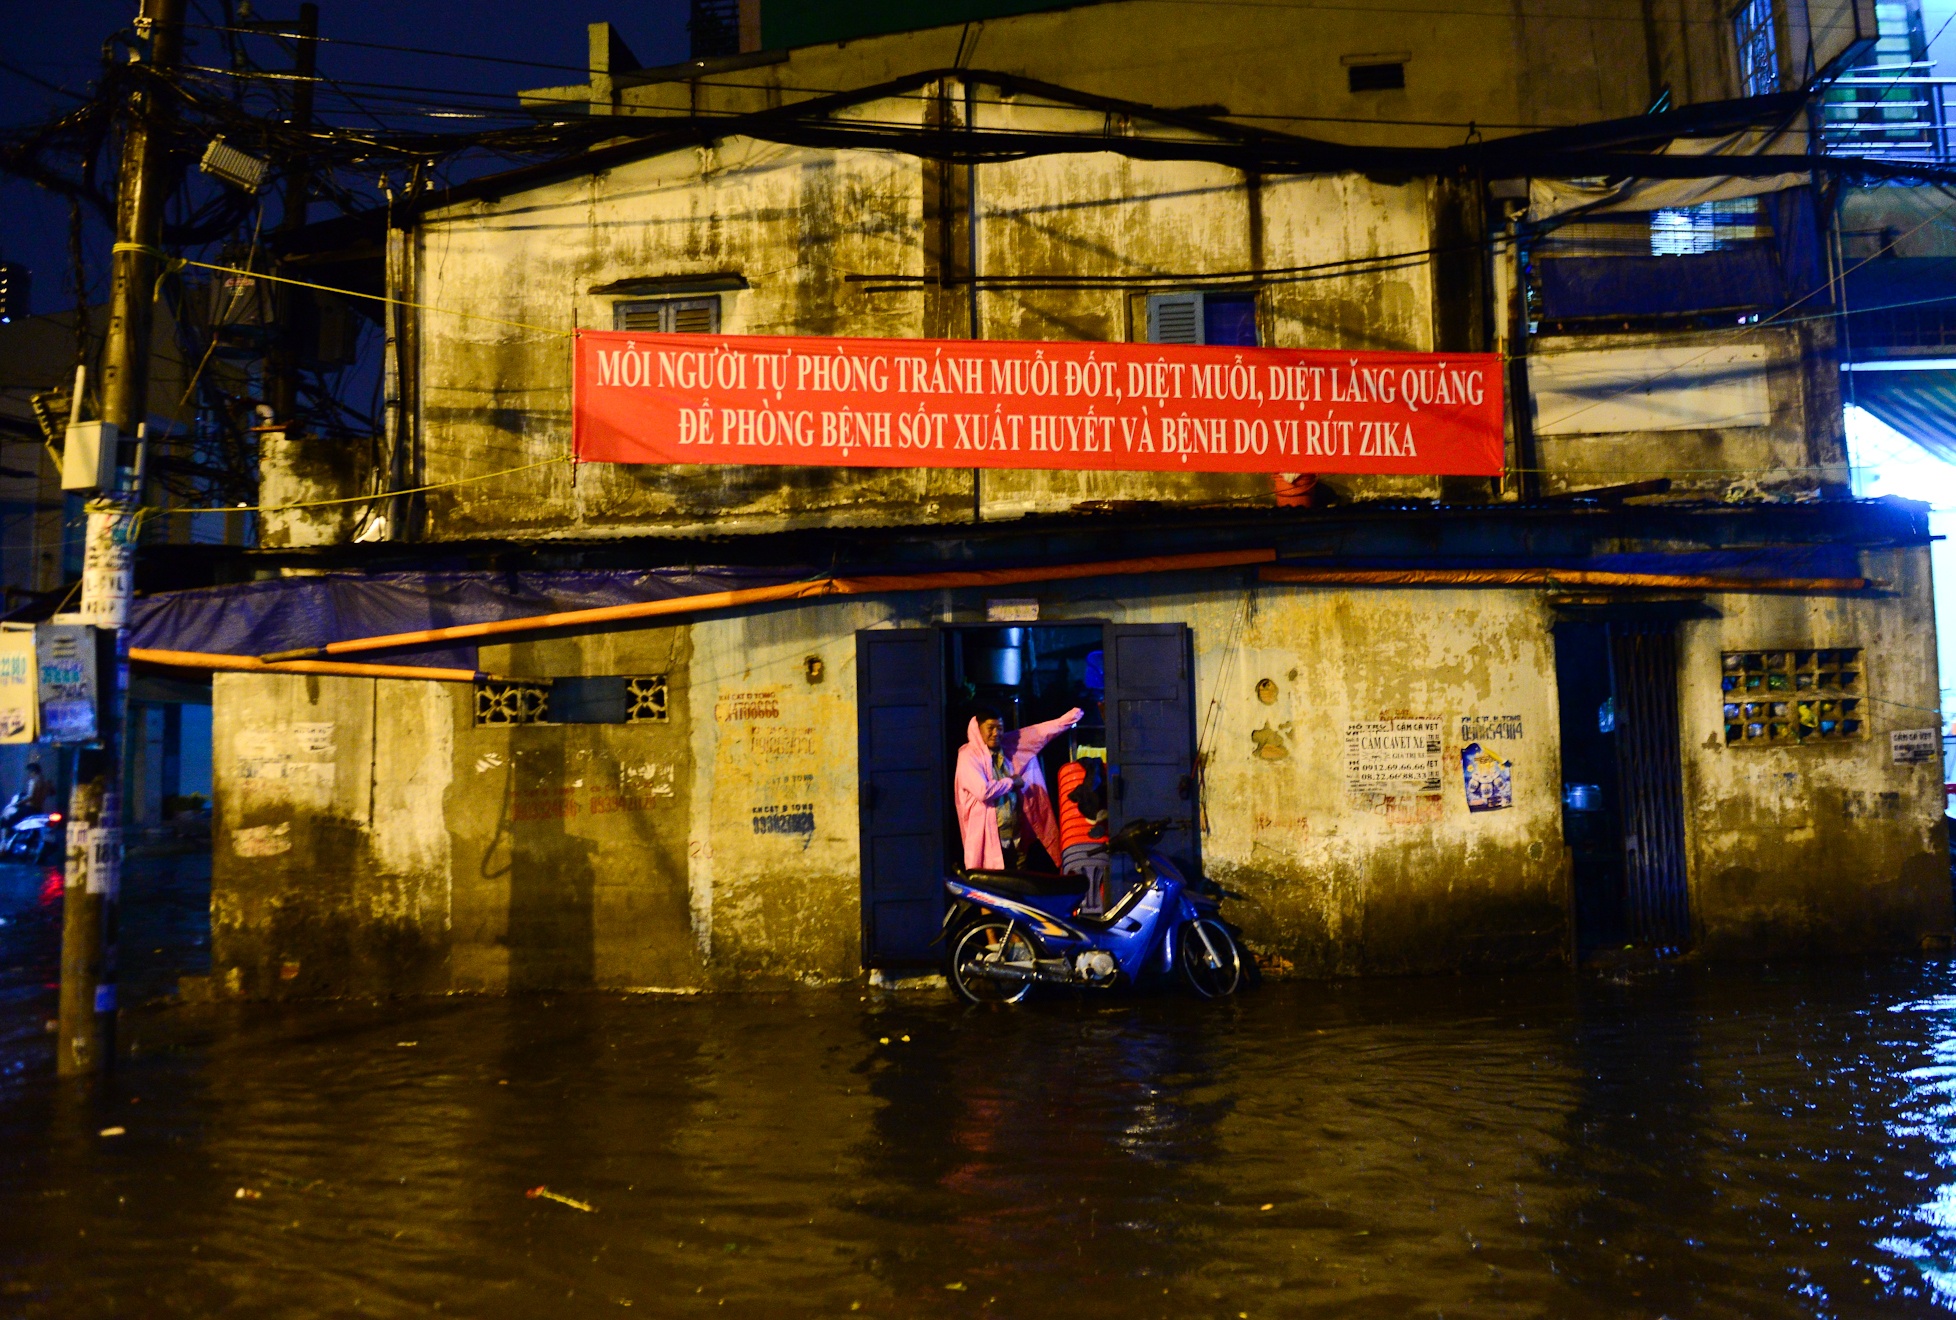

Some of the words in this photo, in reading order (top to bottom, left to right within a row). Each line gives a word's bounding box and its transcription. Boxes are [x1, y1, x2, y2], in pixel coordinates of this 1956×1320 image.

[596, 340, 652, 388] MỖI
[657, 343, 748, 390] NGƯỜI
[752, 348, 791, 401] TỰ
[796, 345, 890, 393] PHÒNG
[895, 348, 985, 396] TRÁNH
[989, 348, 1059, 398] MUỖI
[1065, 350, 1122, 405] ĐỐT,
[1127, 356, 1186, 409] DIỆT
[1190, 354, 1264, 408] MUỖI,
[1268, 360, 1325, 411] DIỆT
[1330, 358, 1396, 404] LĂNG
[1401, 361, 1484, 412] QUĂNG
[677, 397, 715, 445] ĐỂ
[720, 398, 814, 447] PHÒNG
[819, 405, 893, 458] BỆNH
[897, 401, 949, 450] SỐT
[953, 403, 1024, 451] XUẤT
[1029, 405, 1116, 453] HUYẾT
[1120, 405, 1156, 453] VÀ
[1160, 411, 1229, 464] BỆNH
[1233, 419, 1269, 456] DO
[1273, 420, 1300, 456] VI
[1304, 409, 1354, 457] RÚT
[1359, 421, 1418, 457] ZIKA
